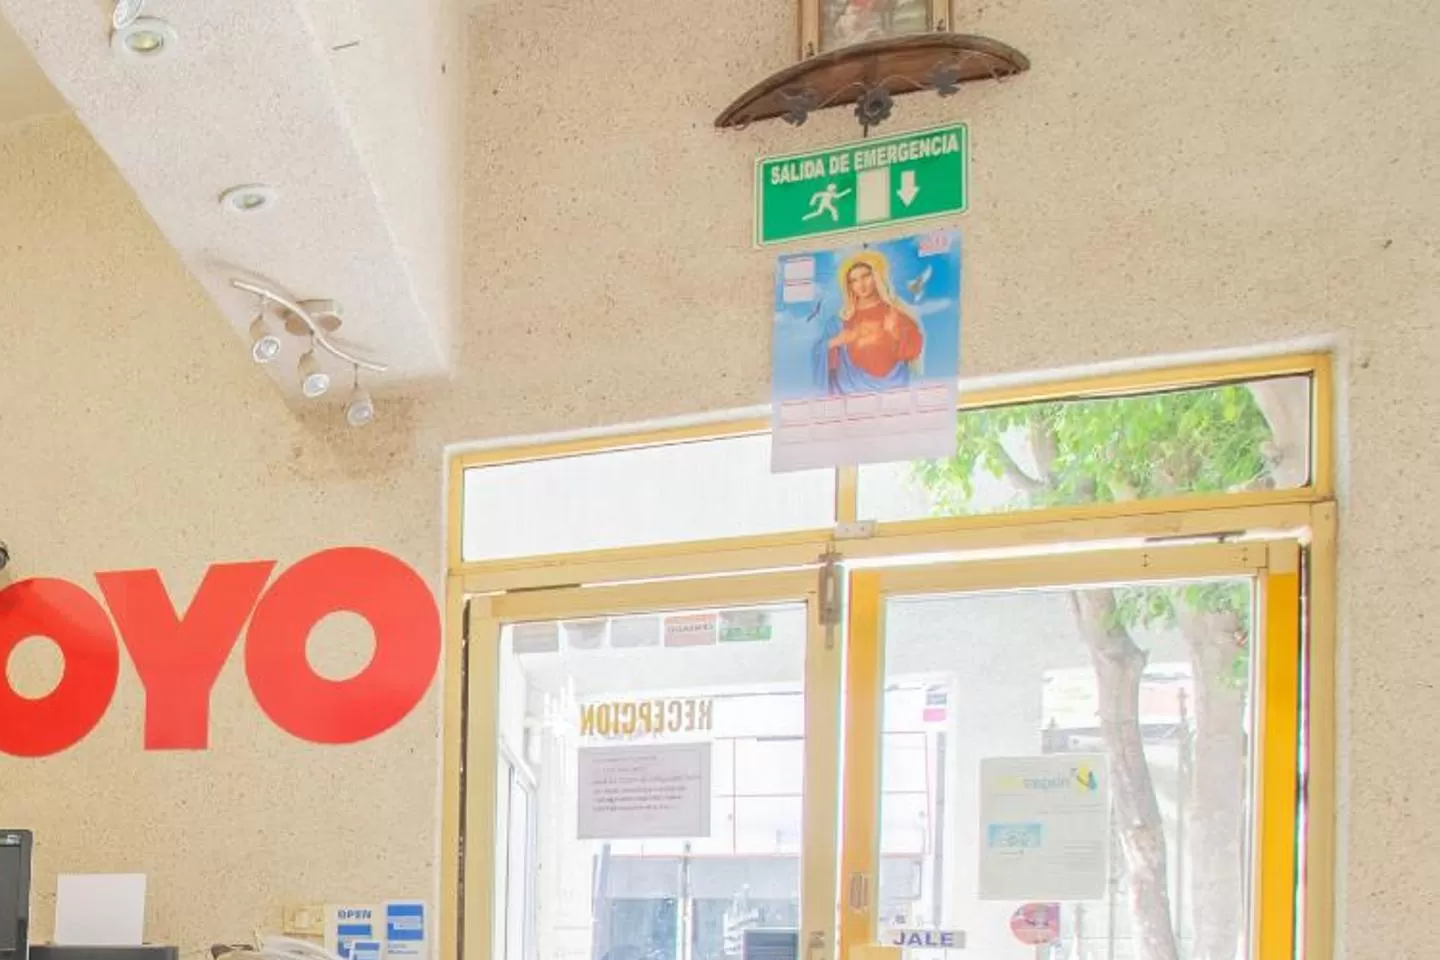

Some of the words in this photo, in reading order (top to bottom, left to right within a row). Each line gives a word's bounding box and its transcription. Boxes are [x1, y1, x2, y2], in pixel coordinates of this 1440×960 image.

[770, 156, 826, 185] SALIDA
[829, 151, 850, 174] DE
[853, 134, 960, 171] EMERGENCIA
[892, 931, 955, 946] JALE
